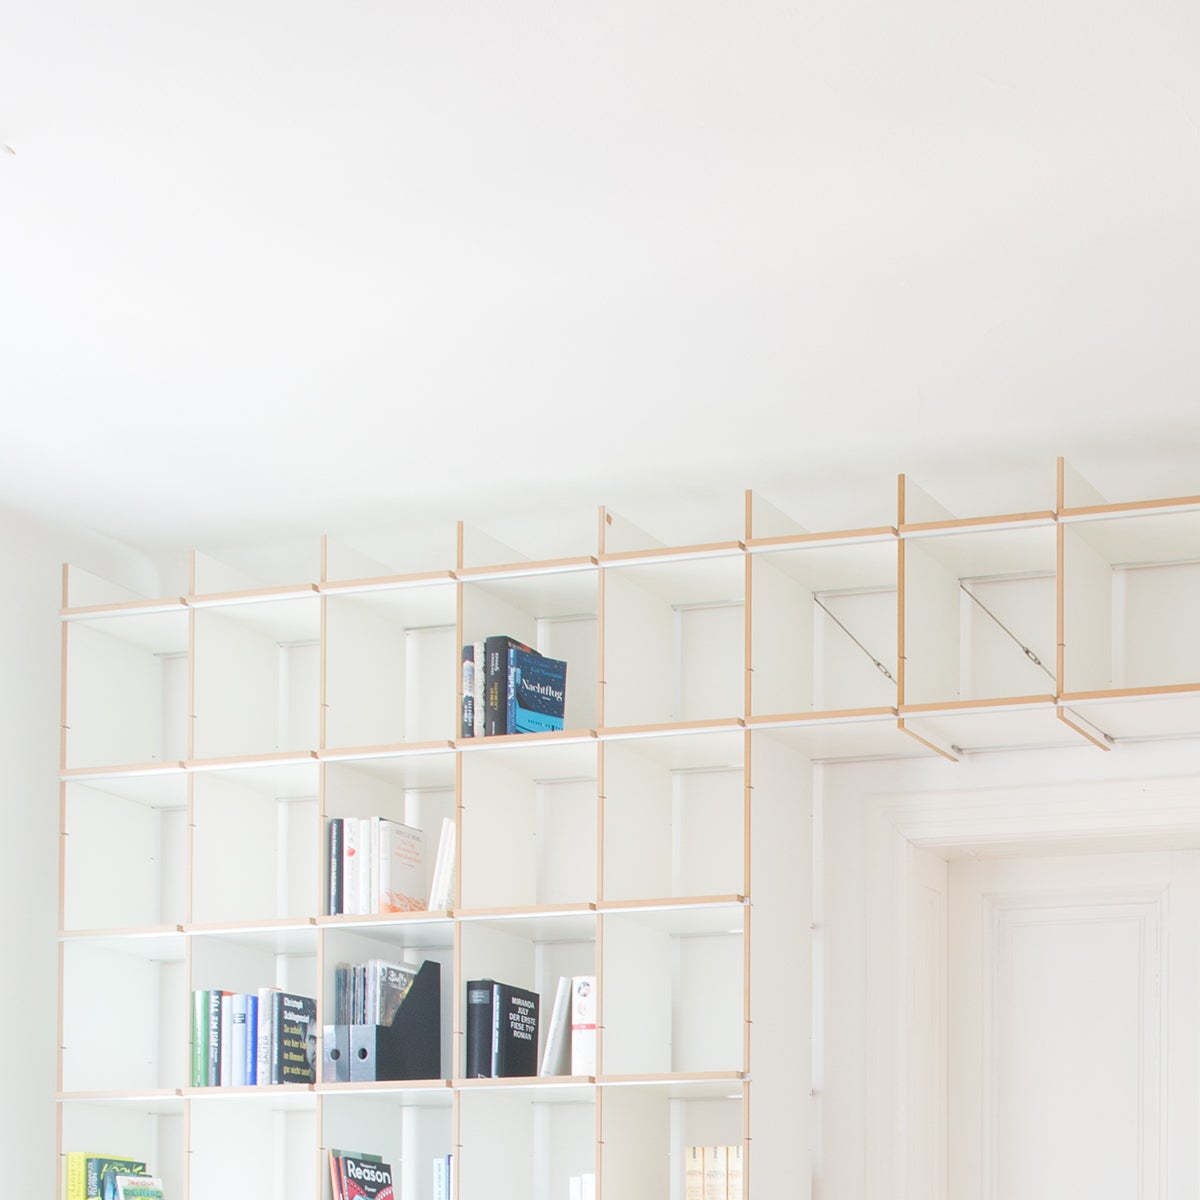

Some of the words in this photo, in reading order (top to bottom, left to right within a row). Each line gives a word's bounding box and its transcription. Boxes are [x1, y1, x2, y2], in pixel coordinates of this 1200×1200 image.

[521, 678, 563, 702] Nachtflug
[511, 997, 535, 1009] MIRANDA
[517, 1007, 529, 1016] JULY
[509, 1013, 520, 1021] DER
[521, 1015, 536, 1026] ERSTE
[510, 1021, 525, 1031] FIESE
[526, 1025, 535, 1033] TYP
[513, 1030, 532, 1040] ROMAN
[347, 1160, 391, 1184] Reason
